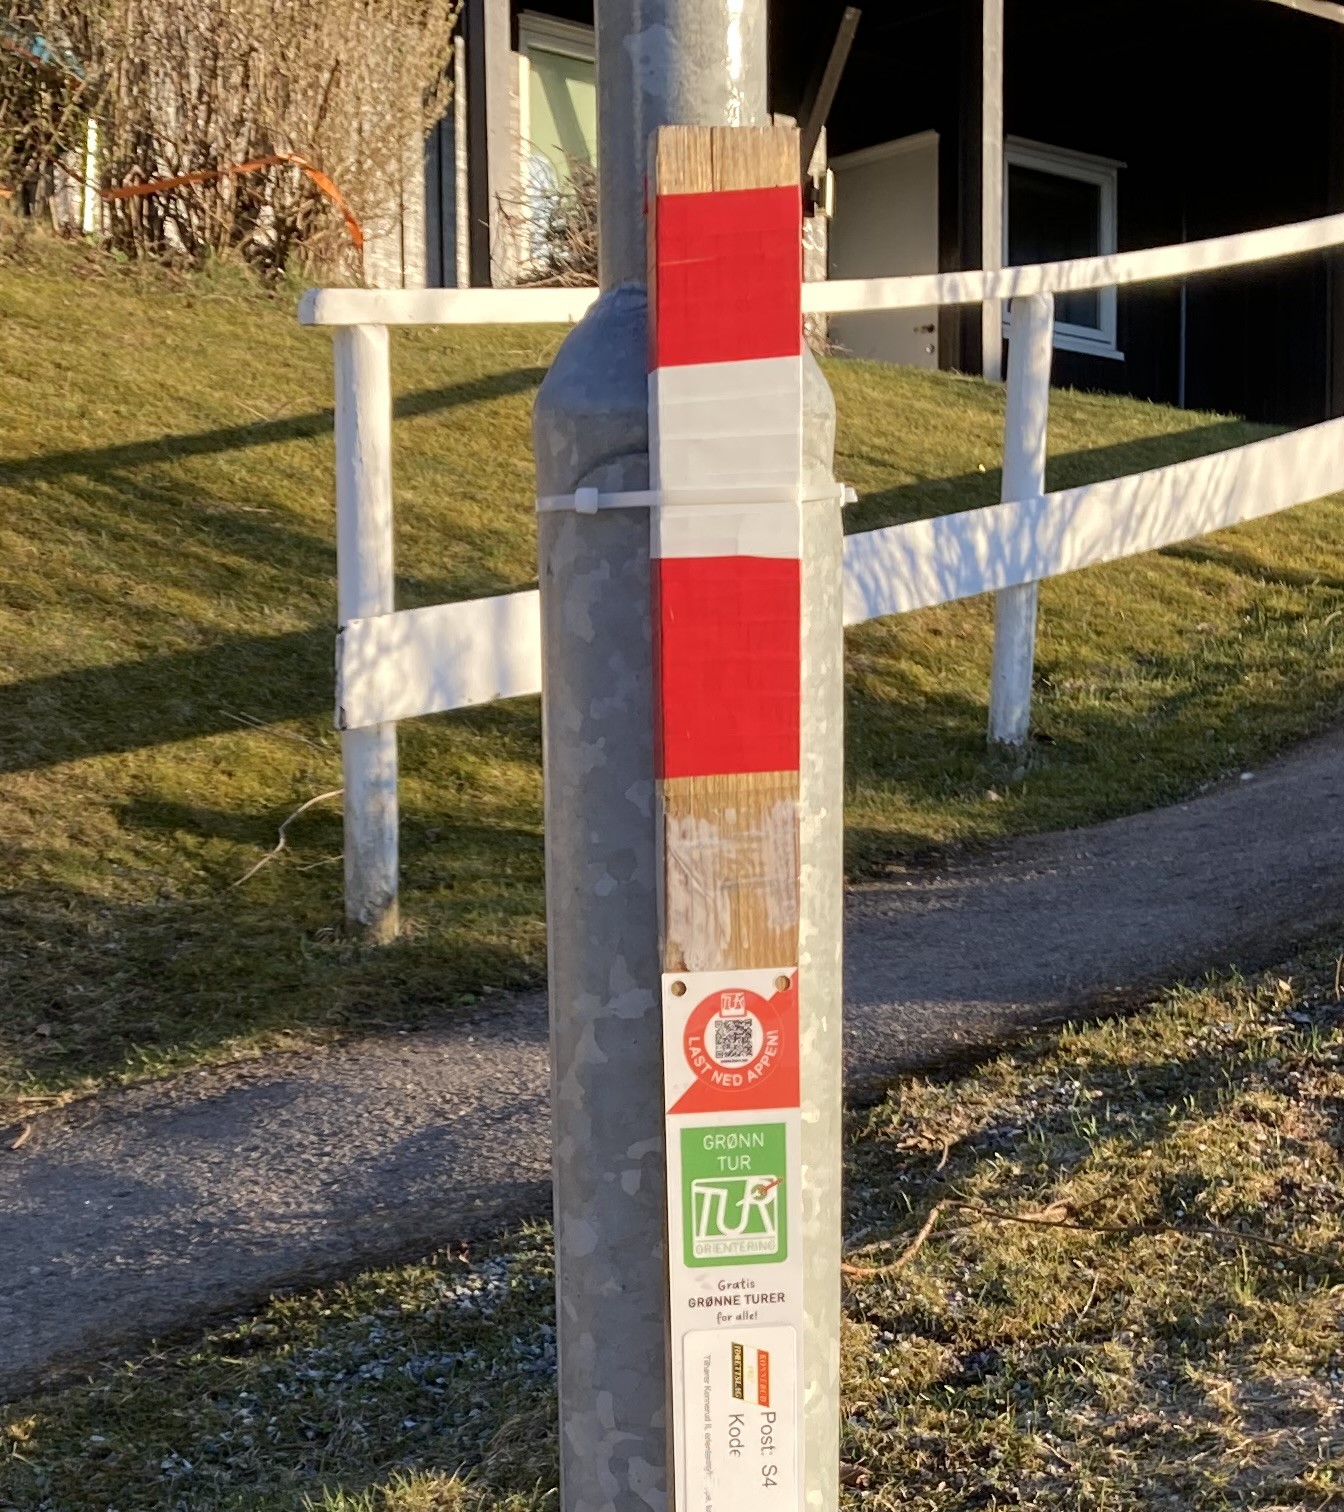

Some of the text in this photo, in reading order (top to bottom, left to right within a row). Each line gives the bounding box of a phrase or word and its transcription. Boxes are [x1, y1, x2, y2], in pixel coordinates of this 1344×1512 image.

[711, 1073, 743, 1087] NED
[702, 1132, 765, 1151] GRØNN
[717, 1154, 751, 1171] TUR
[695, 1238, 776, 1256] ORIENTERING
[717, 1278, 756, 1291] Gratis
[688, 1292, 786, 1308] GRØNNE TURER
[716, 1310, 758, 1325] for alle!
[760, 1411, 778, 1488] Post: S4
